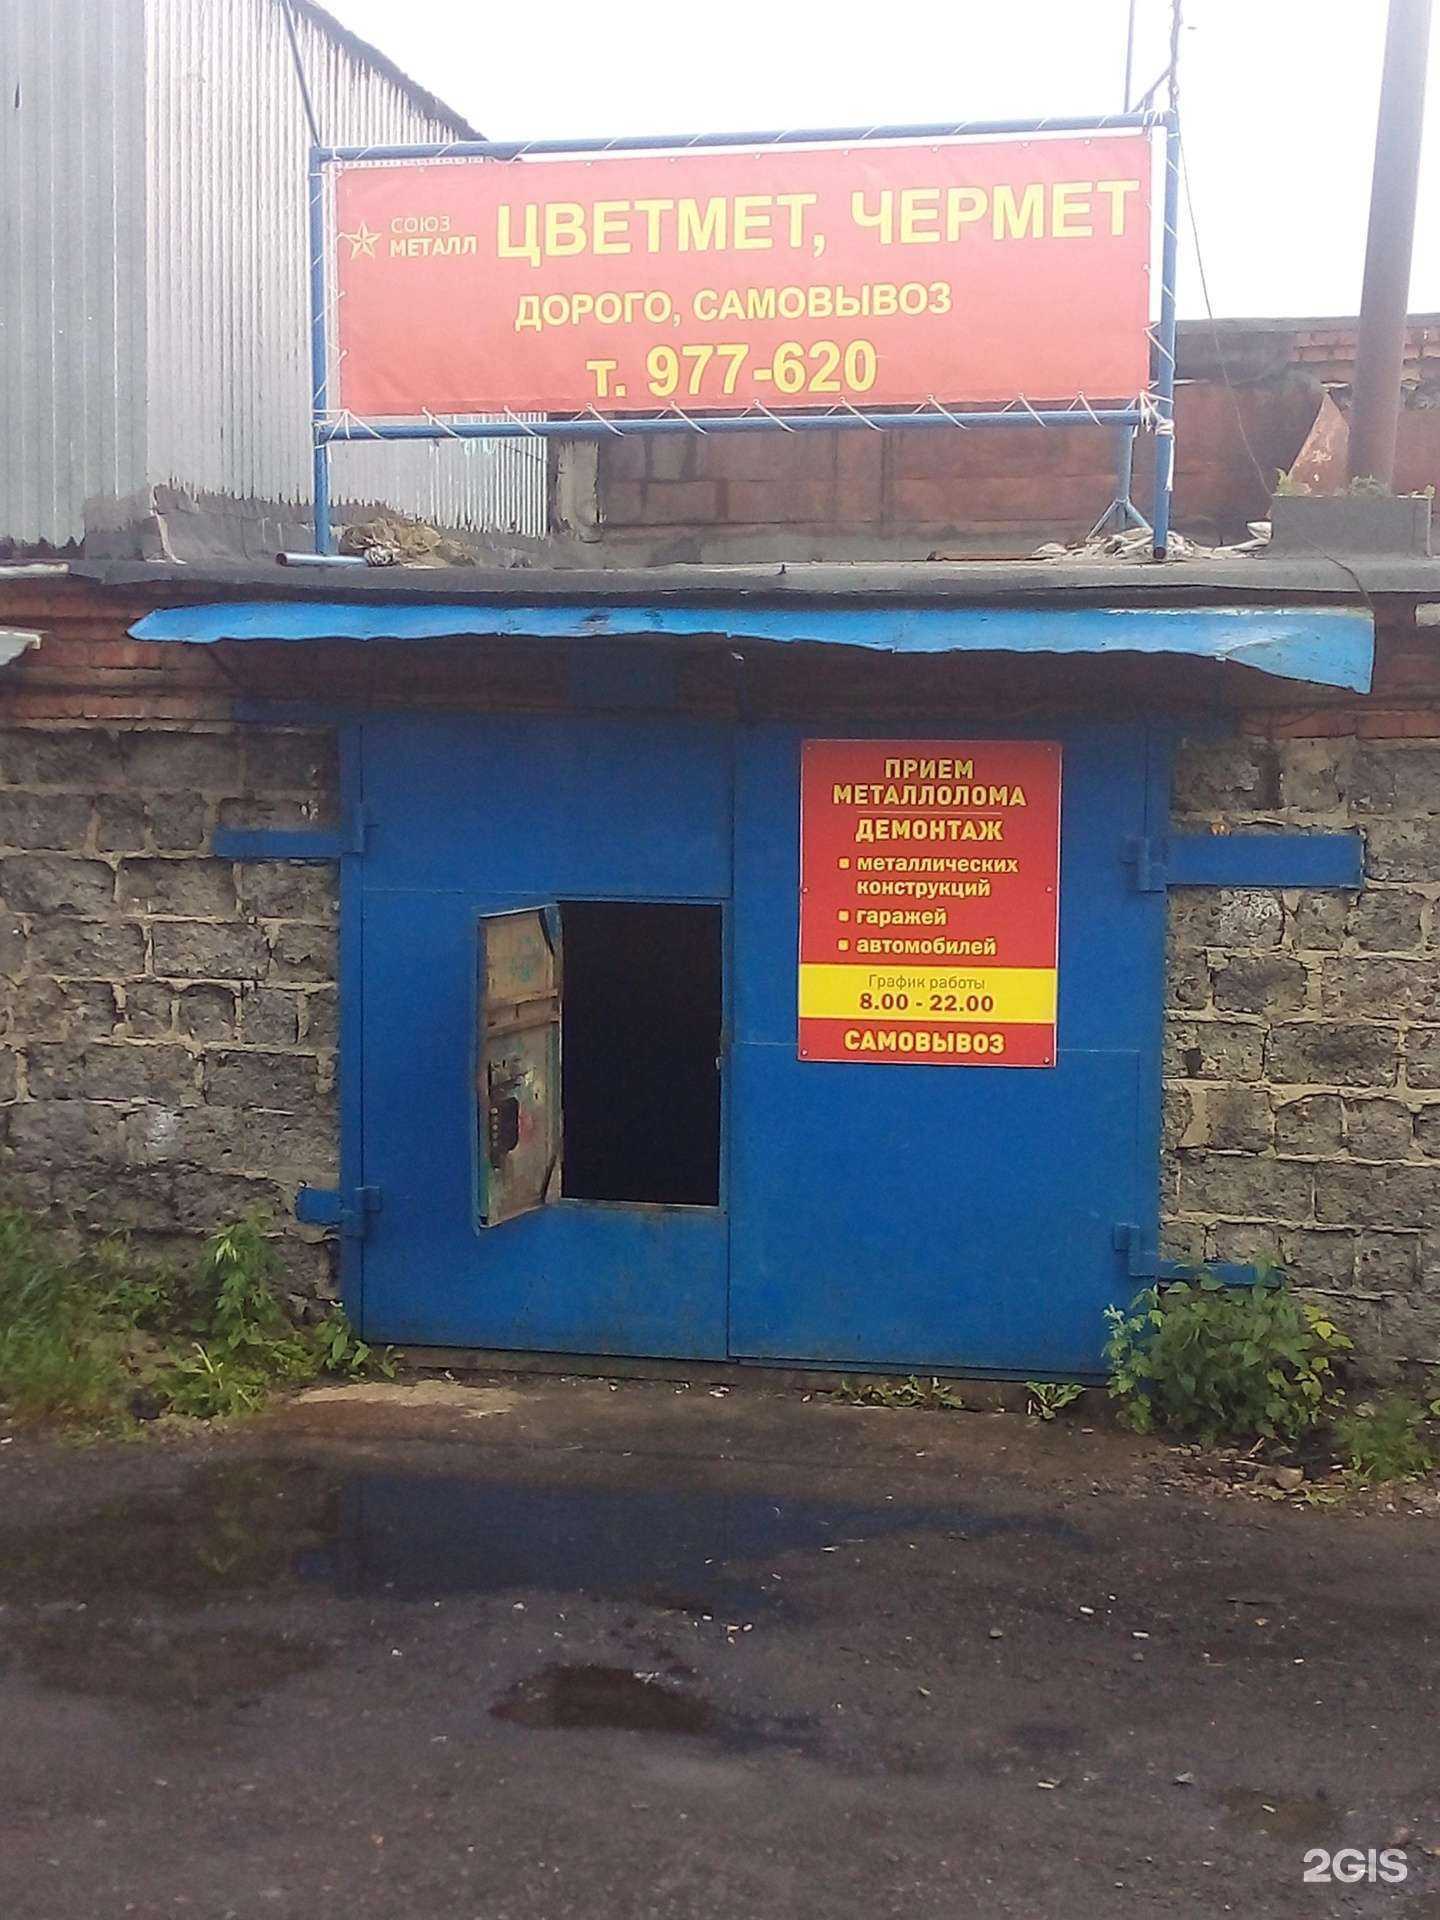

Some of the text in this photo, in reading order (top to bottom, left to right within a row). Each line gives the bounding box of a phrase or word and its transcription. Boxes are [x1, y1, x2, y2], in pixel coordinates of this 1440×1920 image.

[390, 215, 451, 234] СОЮЗ
[497, 180, 1140, 267] ЦВЕТМЕТ, ЧЕРМЕТ
[389, 235, 477, 258] МЕТАЛЛ
[514, 282, 952, 332] ДОРОГО, САМОВЫВОЗ
[646, 339, 878, 398] 977-620
[884, 758, 974, 779] ПРИЕМ
[832, 784, 1027, 807] МЕТАЛЛОЛОМА
[855, 819, 1003, 843] ДЕМОНТАЖ
[856, 855, 1019, 873] металлических
[856, 879, 991, 899] конструкций
[856, 907, 947, 928] гаражей
[856, 937, 997, 956] автомобилей
[868, 974, 985, 991] График работы
[859, 993, 908, 1010] 8.00
[929, 995, 994, 1012] 22.00
[844, 1029, 1005, 1054] САМОВЫВОЗ
